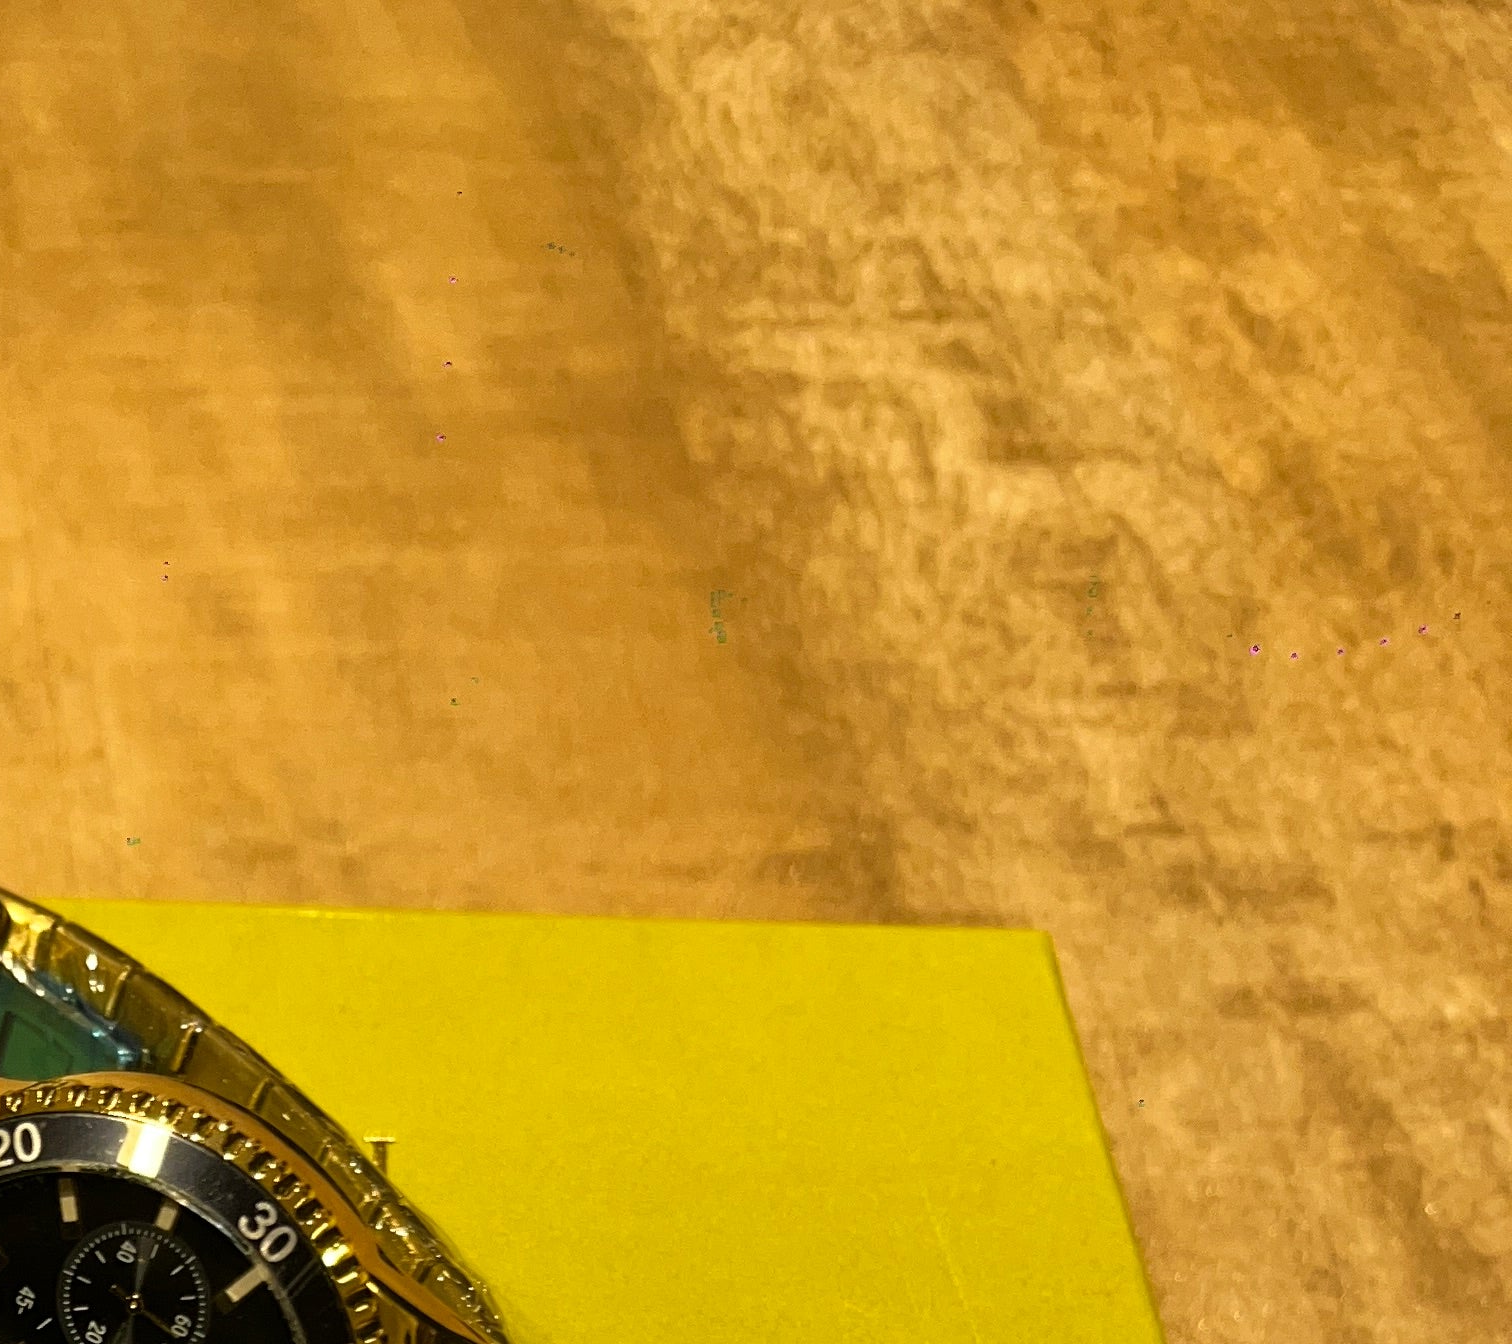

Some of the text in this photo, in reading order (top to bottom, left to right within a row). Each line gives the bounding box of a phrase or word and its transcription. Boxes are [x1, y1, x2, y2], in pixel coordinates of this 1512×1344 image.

[238, 1201, 298, 1263] 30
[116, 1240, 137, 1264] 40
[85, 1320, 107, 1344] 20
